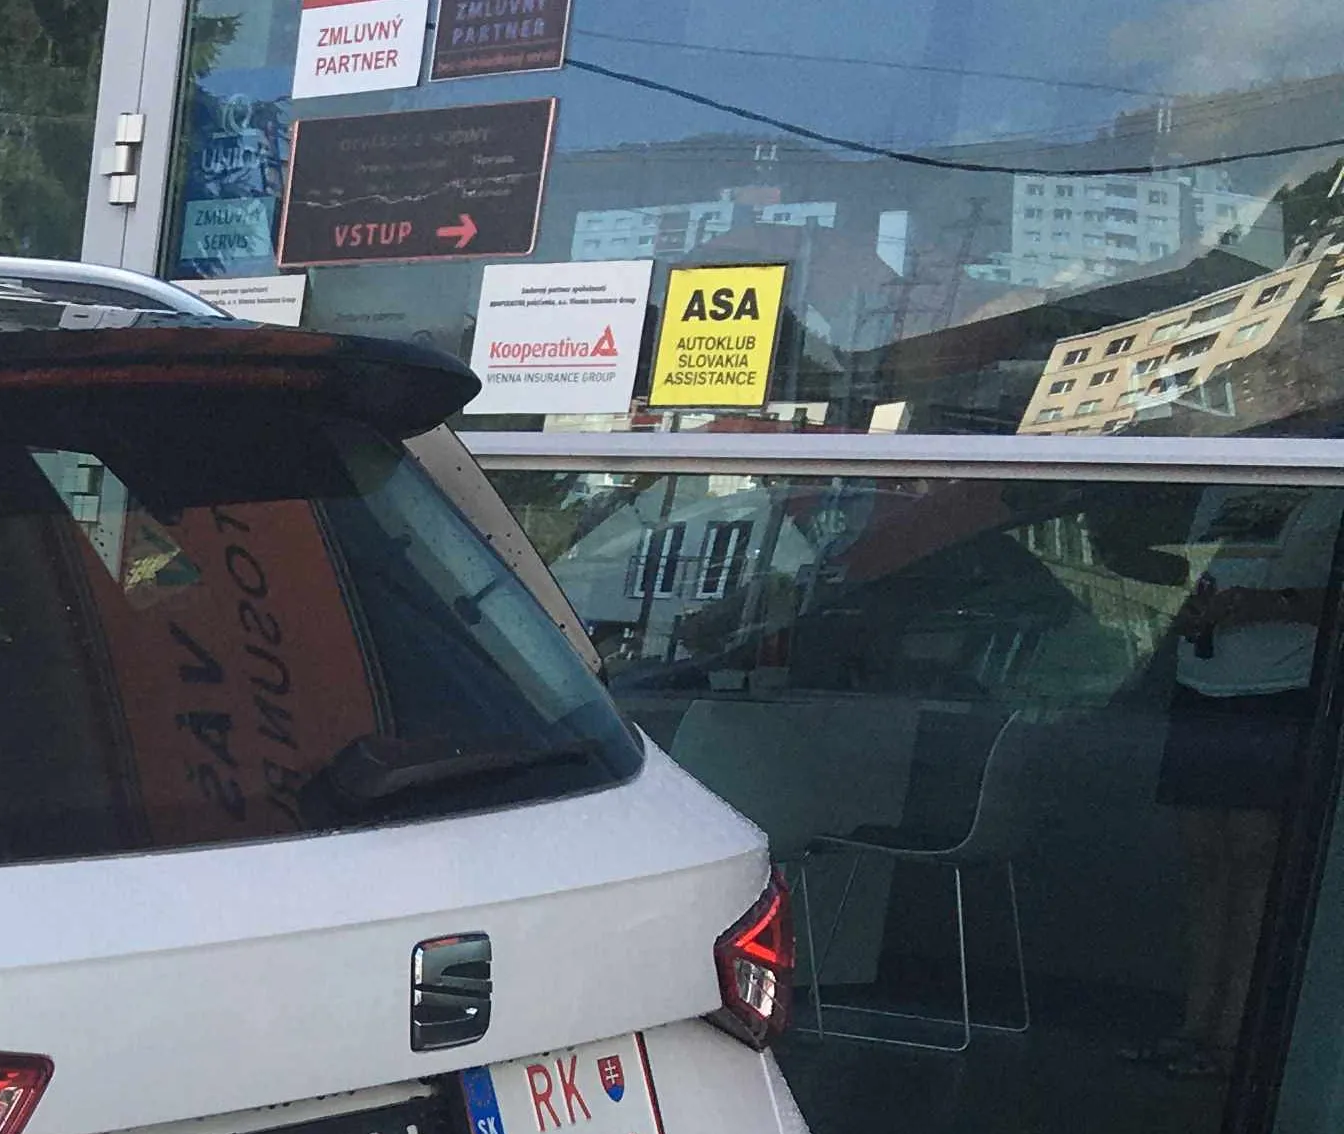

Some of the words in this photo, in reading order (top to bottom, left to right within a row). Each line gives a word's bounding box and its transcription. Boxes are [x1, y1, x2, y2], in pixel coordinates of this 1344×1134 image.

[317, 14, 403, 46] ZMLUVNÝ
[452, 17, 545, 45] PARTNER
[316, 49, 398, 75] PARTNER
[203, 234, 248, 250] SERVIS
[335, 221, 412, 247] VSTUP
[681, 287, 760, 321] ASA
[490, 337, 589, 363] Kooperativa
[676, 336, 756, 351] AUTOKLUB
[678, 354, 749, 368] SLOVAKIA
[487, 373, 521, 384] VIENNA
[523, 372, 579, 383] INSURANCE
[582, 372, 616, 382] GROUP
[664, 371, 757, 385] ASSISTANCE
[524, 1055, 592, 1132] RK
